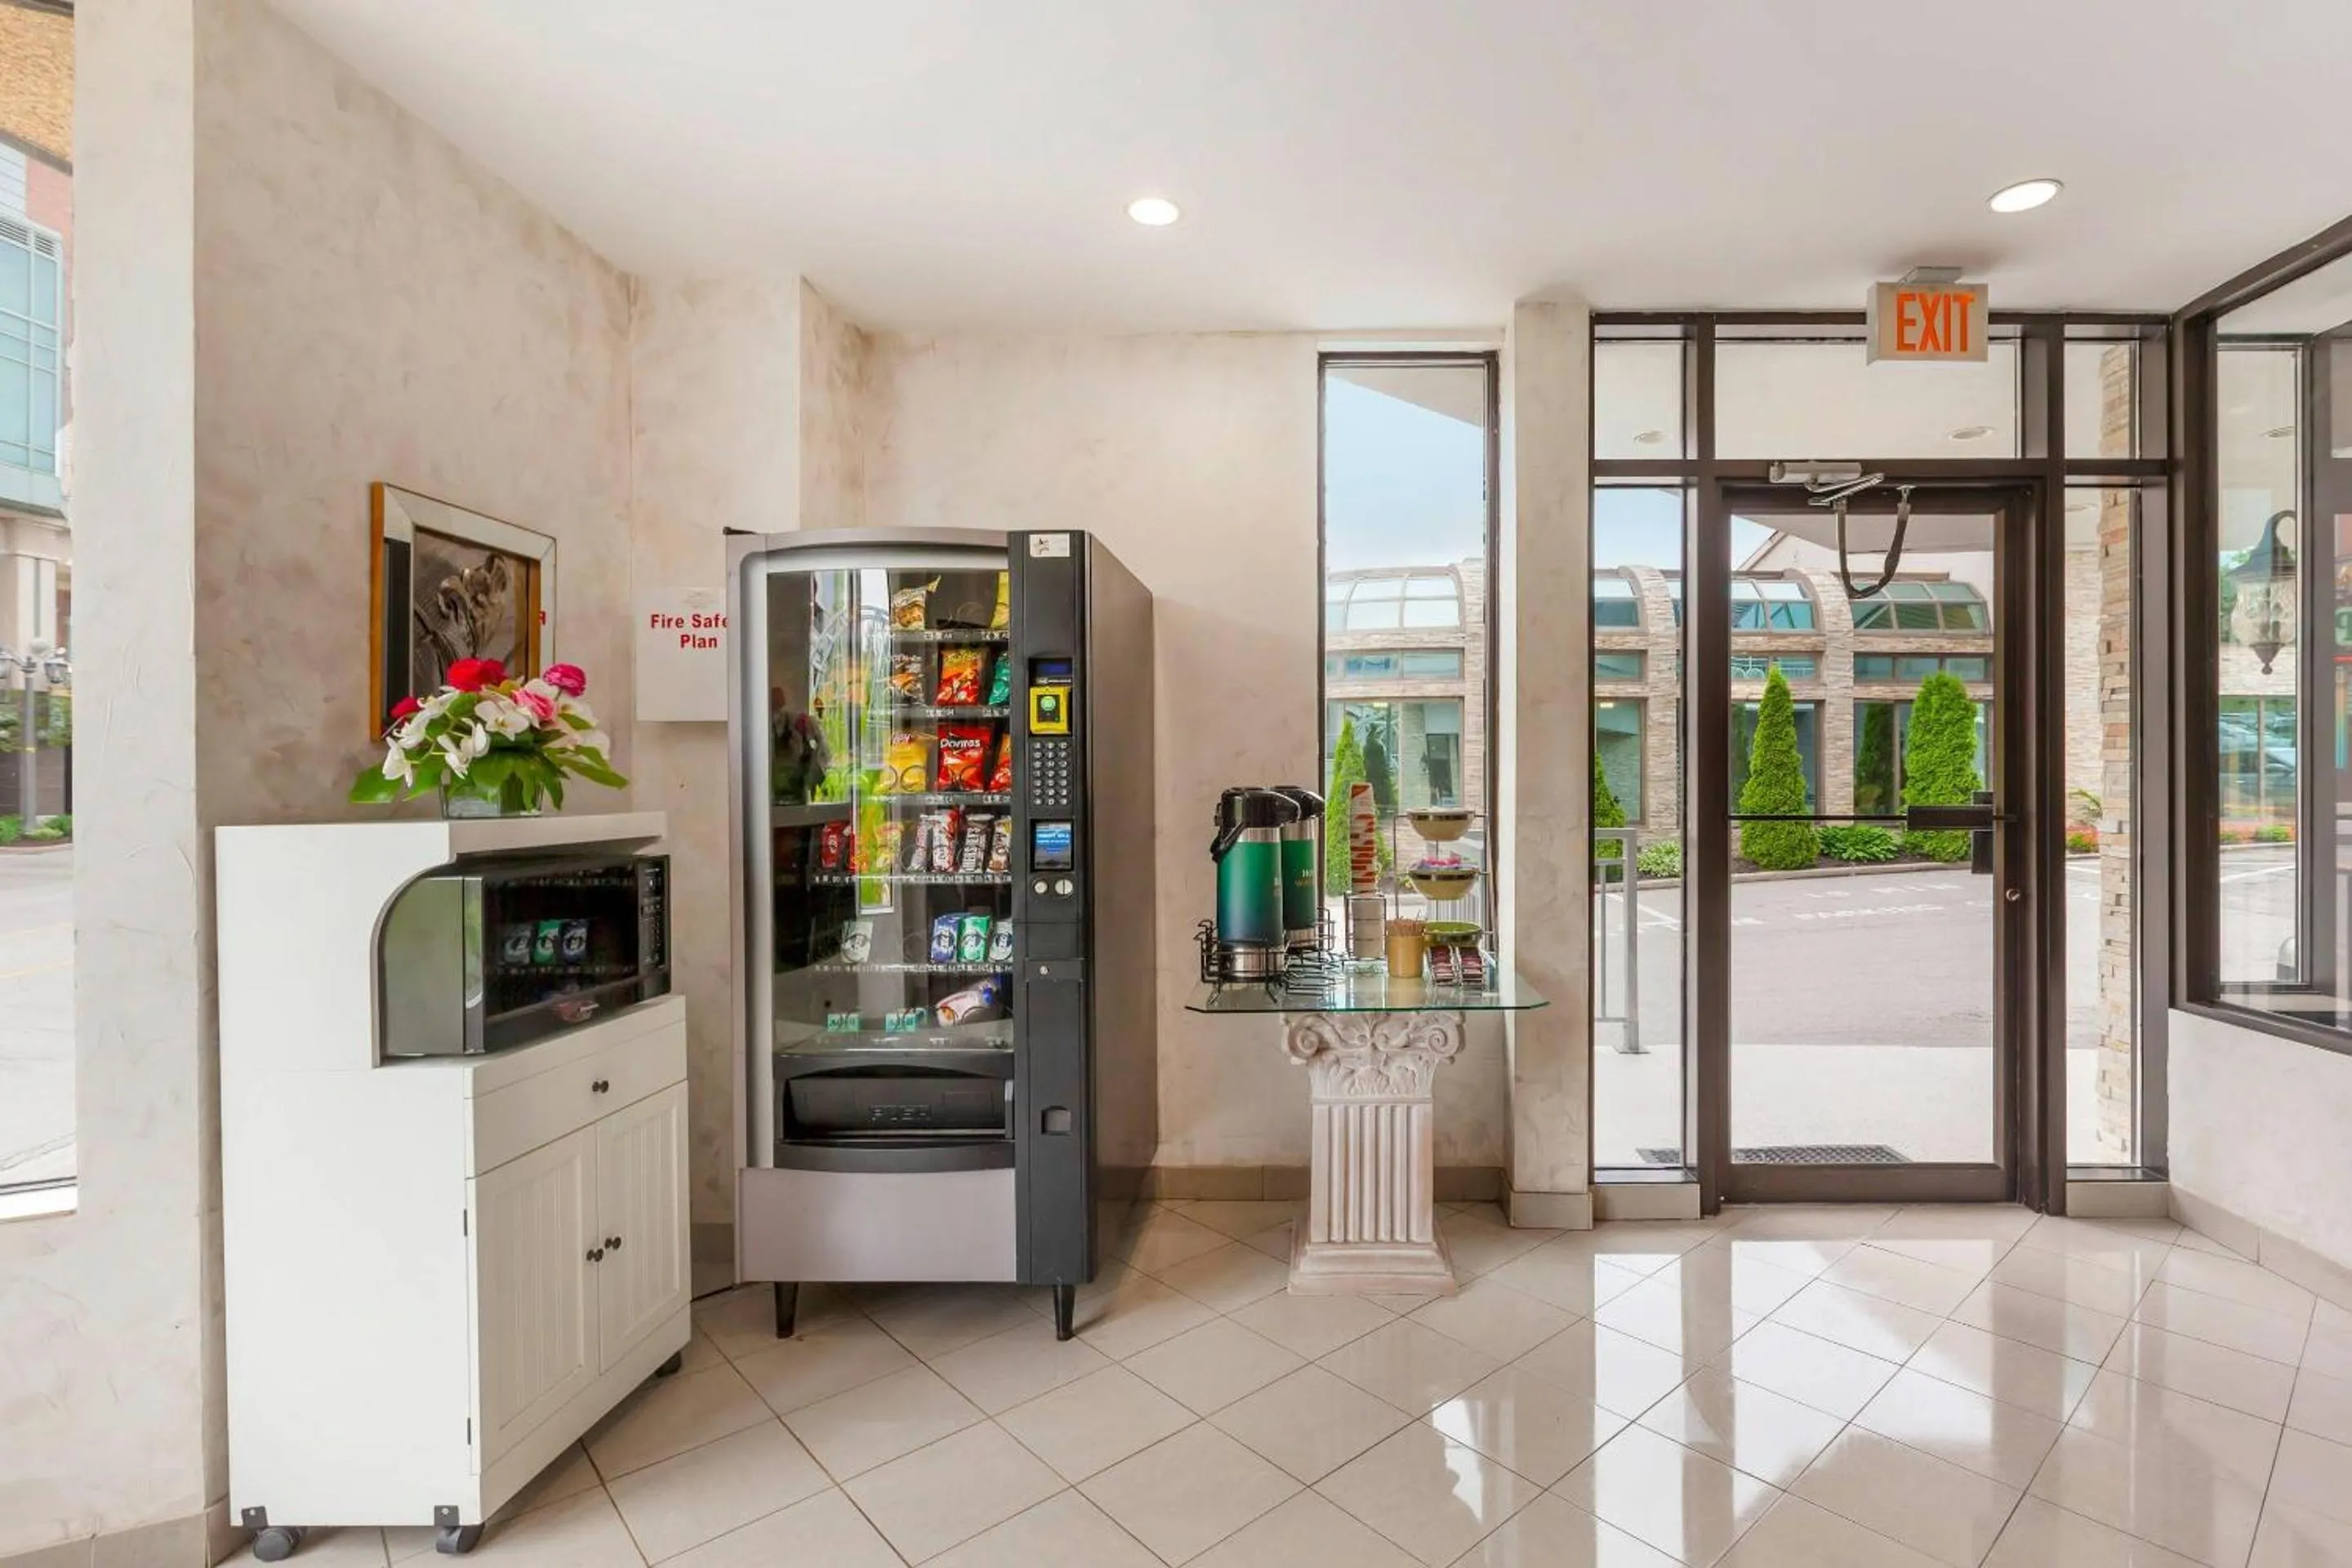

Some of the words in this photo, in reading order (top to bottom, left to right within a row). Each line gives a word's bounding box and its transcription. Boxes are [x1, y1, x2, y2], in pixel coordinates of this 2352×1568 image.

[1896, 293, 1975, 352] EXIT
[651, 614, 684, 629] Fire
[691, 613, 728, 629] Safe
[679, 634, 718, 648] Plan
[940, 738, 981, 748] Doritos
